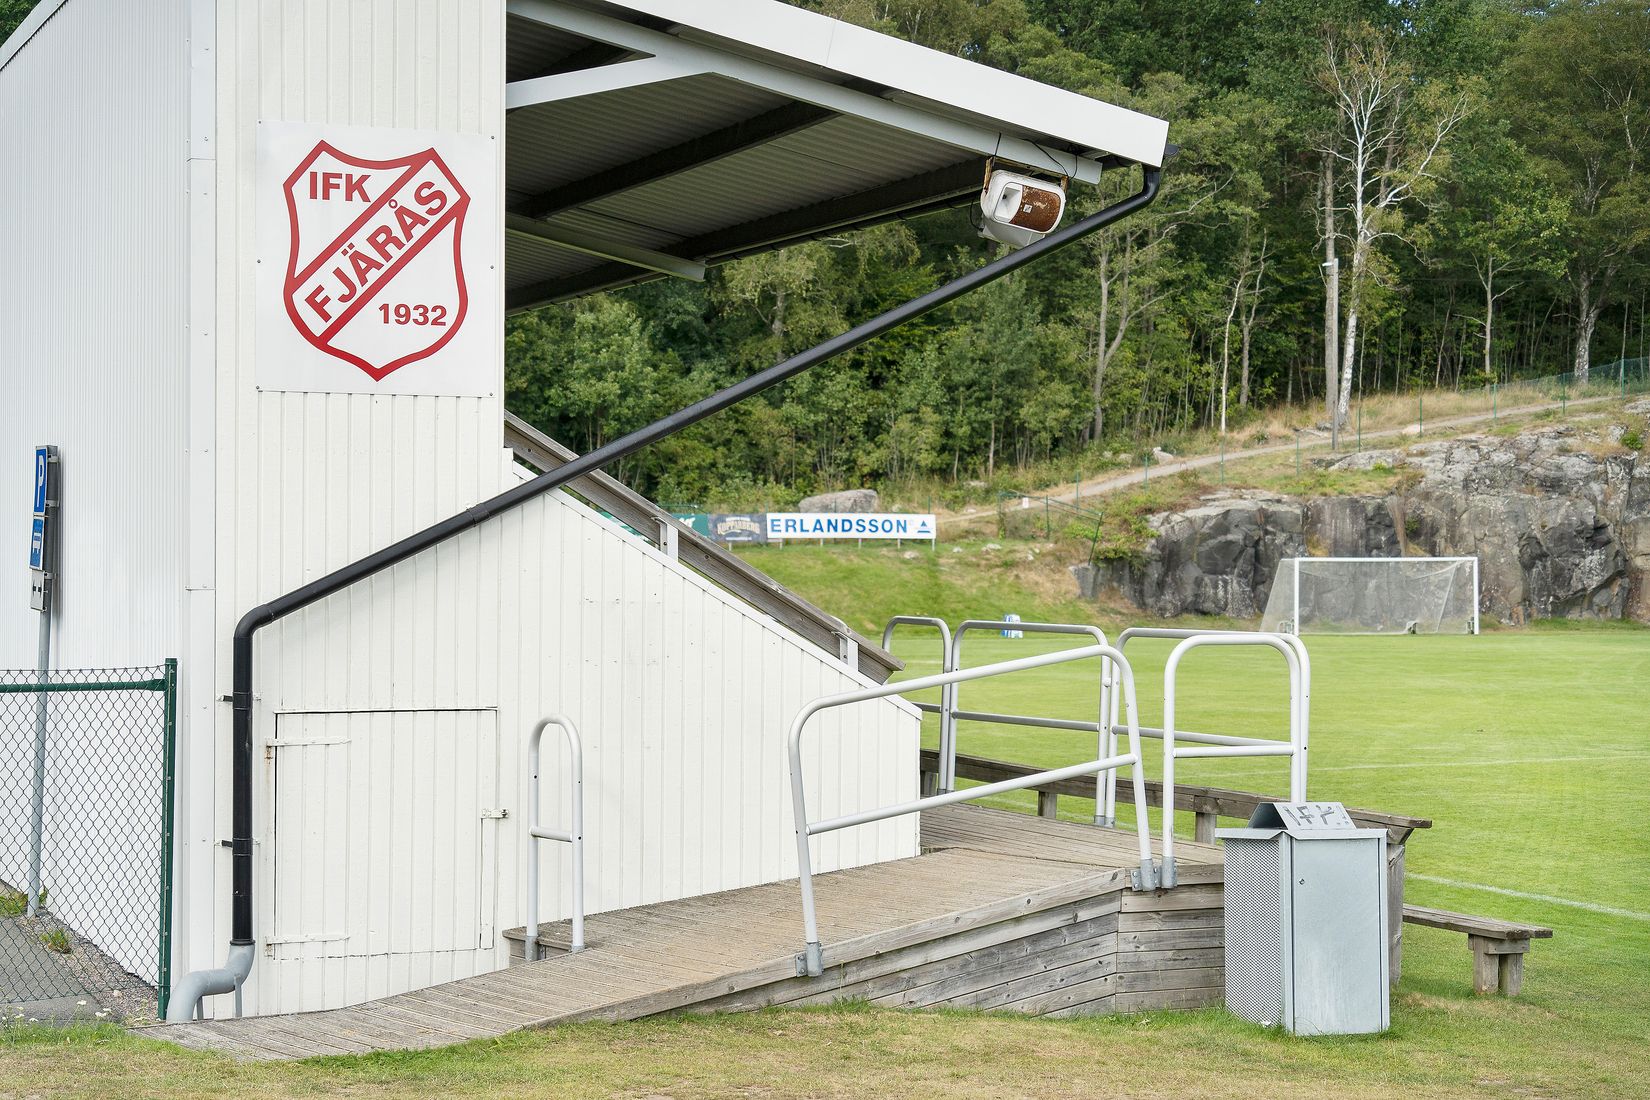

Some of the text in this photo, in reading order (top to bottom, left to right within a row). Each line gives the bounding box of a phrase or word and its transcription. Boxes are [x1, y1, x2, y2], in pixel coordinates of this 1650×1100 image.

[309, 171, 371, 203] IFK
[304, 181, 447, 323] FJÄRÅS
[379, 303, 447, 327] 1932
[36, 454, 45, 508] P
[770, 518, 908, 534] ERLANDSSON
